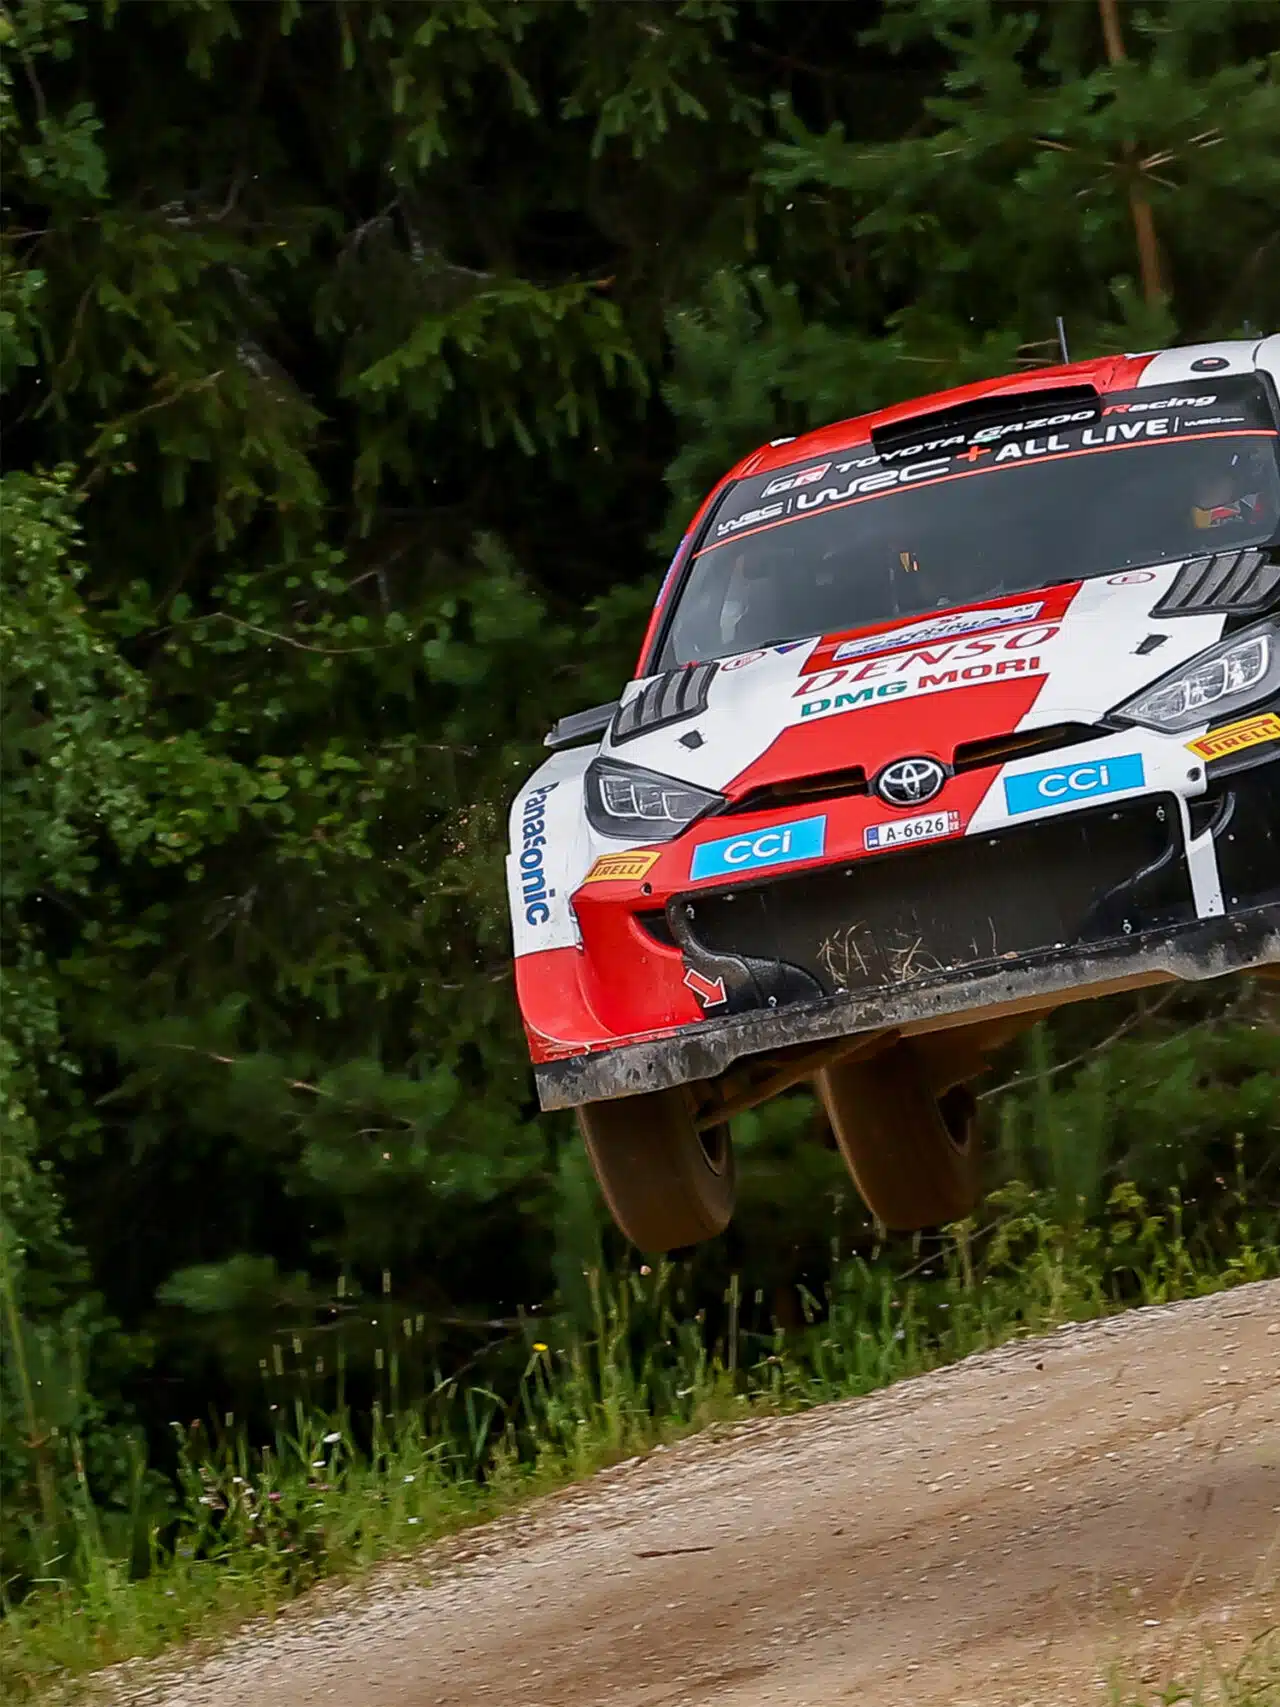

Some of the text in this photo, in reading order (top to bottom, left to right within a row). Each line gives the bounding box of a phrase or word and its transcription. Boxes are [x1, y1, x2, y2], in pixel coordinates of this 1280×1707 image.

[835, 434, 965, 472] TOYOTA
[968, 409, 1096, 444] GAZOO
[1102, 394, 1218, 417] Racing
[995, 434, 1070, 462] ALL
[1081, 418, 1169, 446] LIVE
[792, 625, 1060, 698] DENSO
[801, 656, 1040, 717] DMG MORI
[519, 781, 560, 926] Panasonic
[886, 817, 944, 842] A-6626
